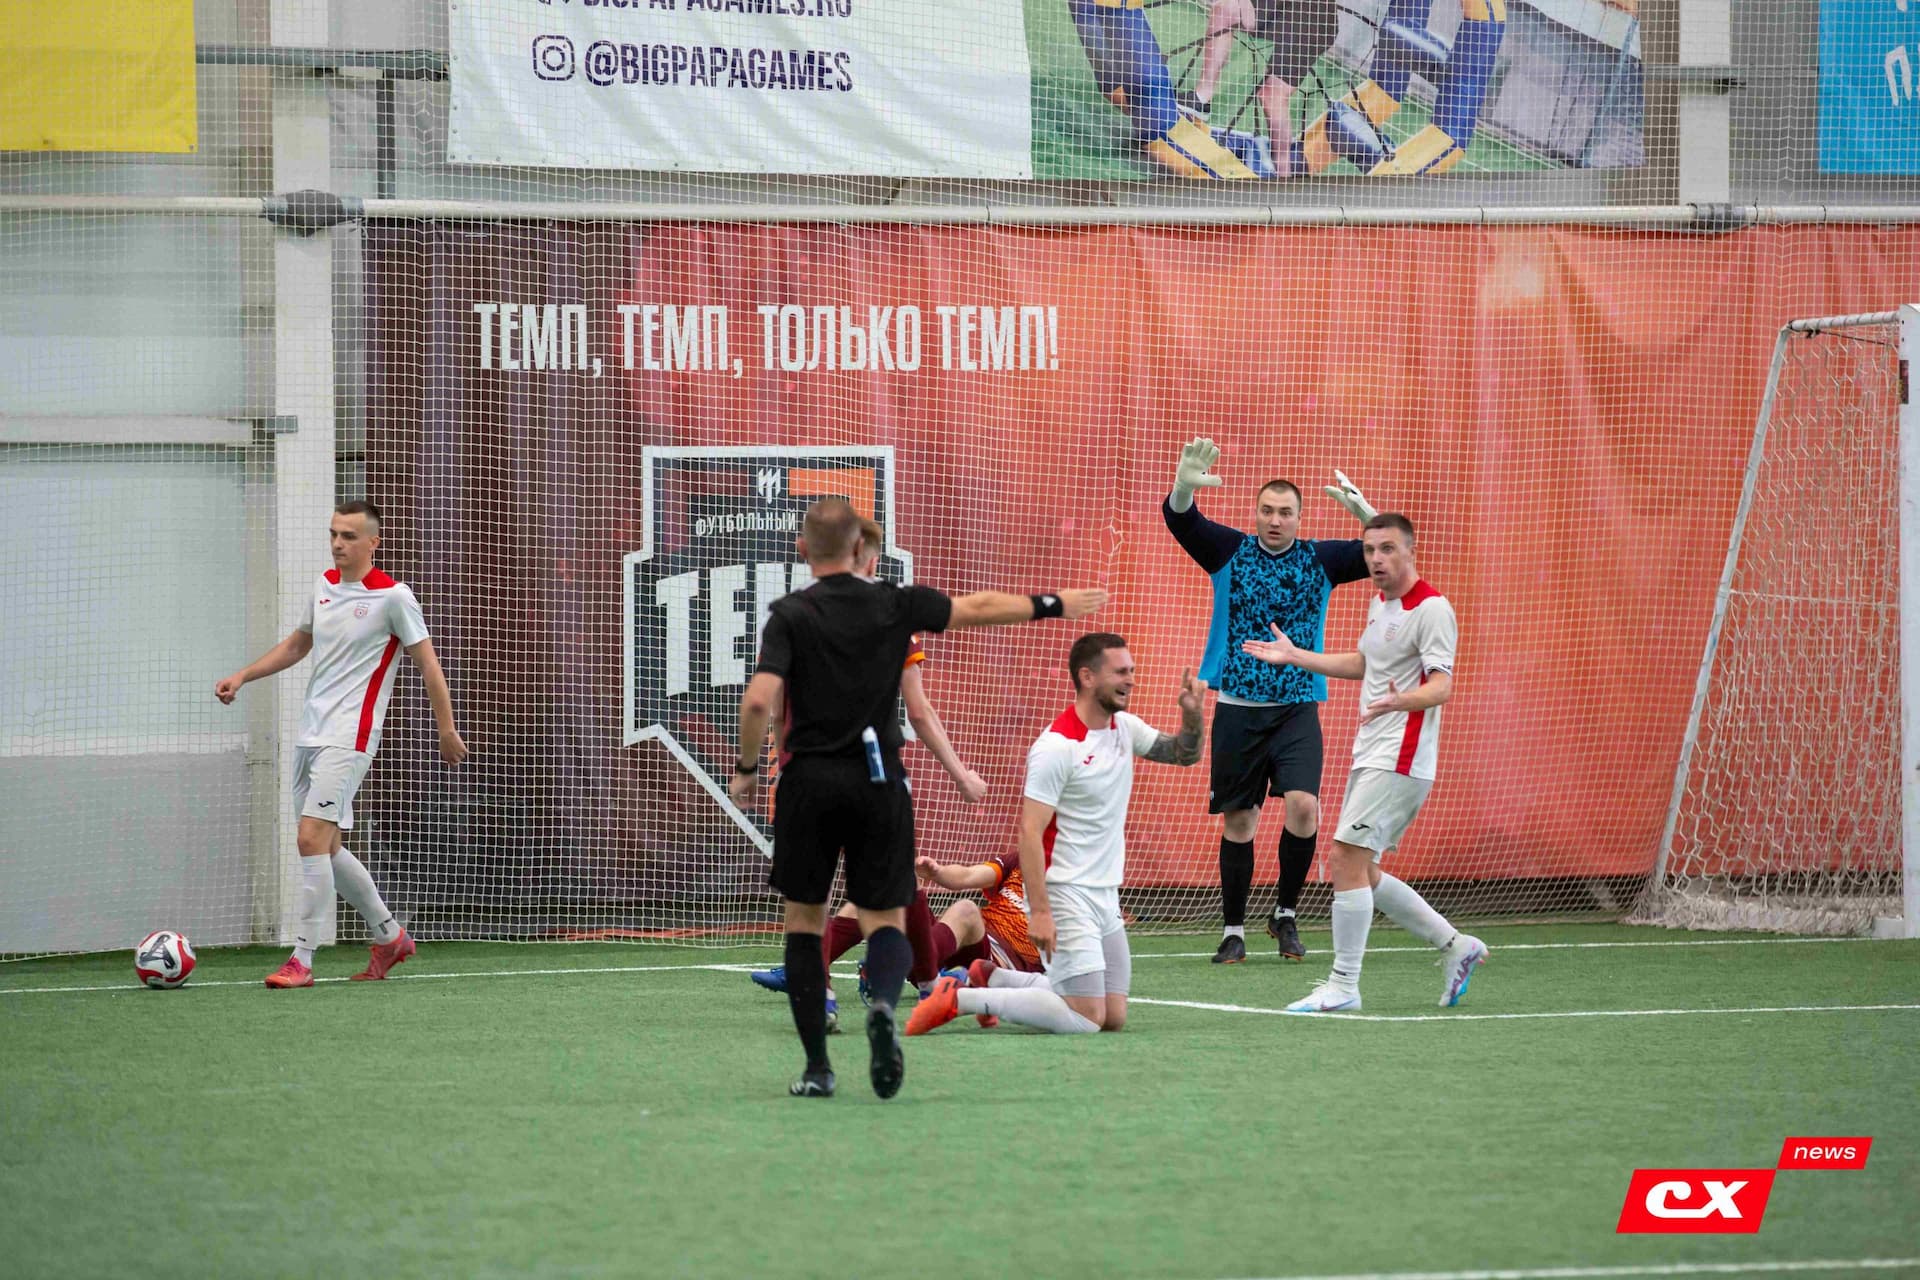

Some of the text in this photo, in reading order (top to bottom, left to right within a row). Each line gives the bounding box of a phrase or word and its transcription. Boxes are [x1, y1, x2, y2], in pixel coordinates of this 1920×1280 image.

[584, 40, 854, 92] @BIGPAPAGAMES
[473, 302, 1060, 378] ТЕМП, ТЕМП, ТОЛЬКО ТЕМП!
[695, 507, 797, 537] ФУТБОЛЬНЫЙ
